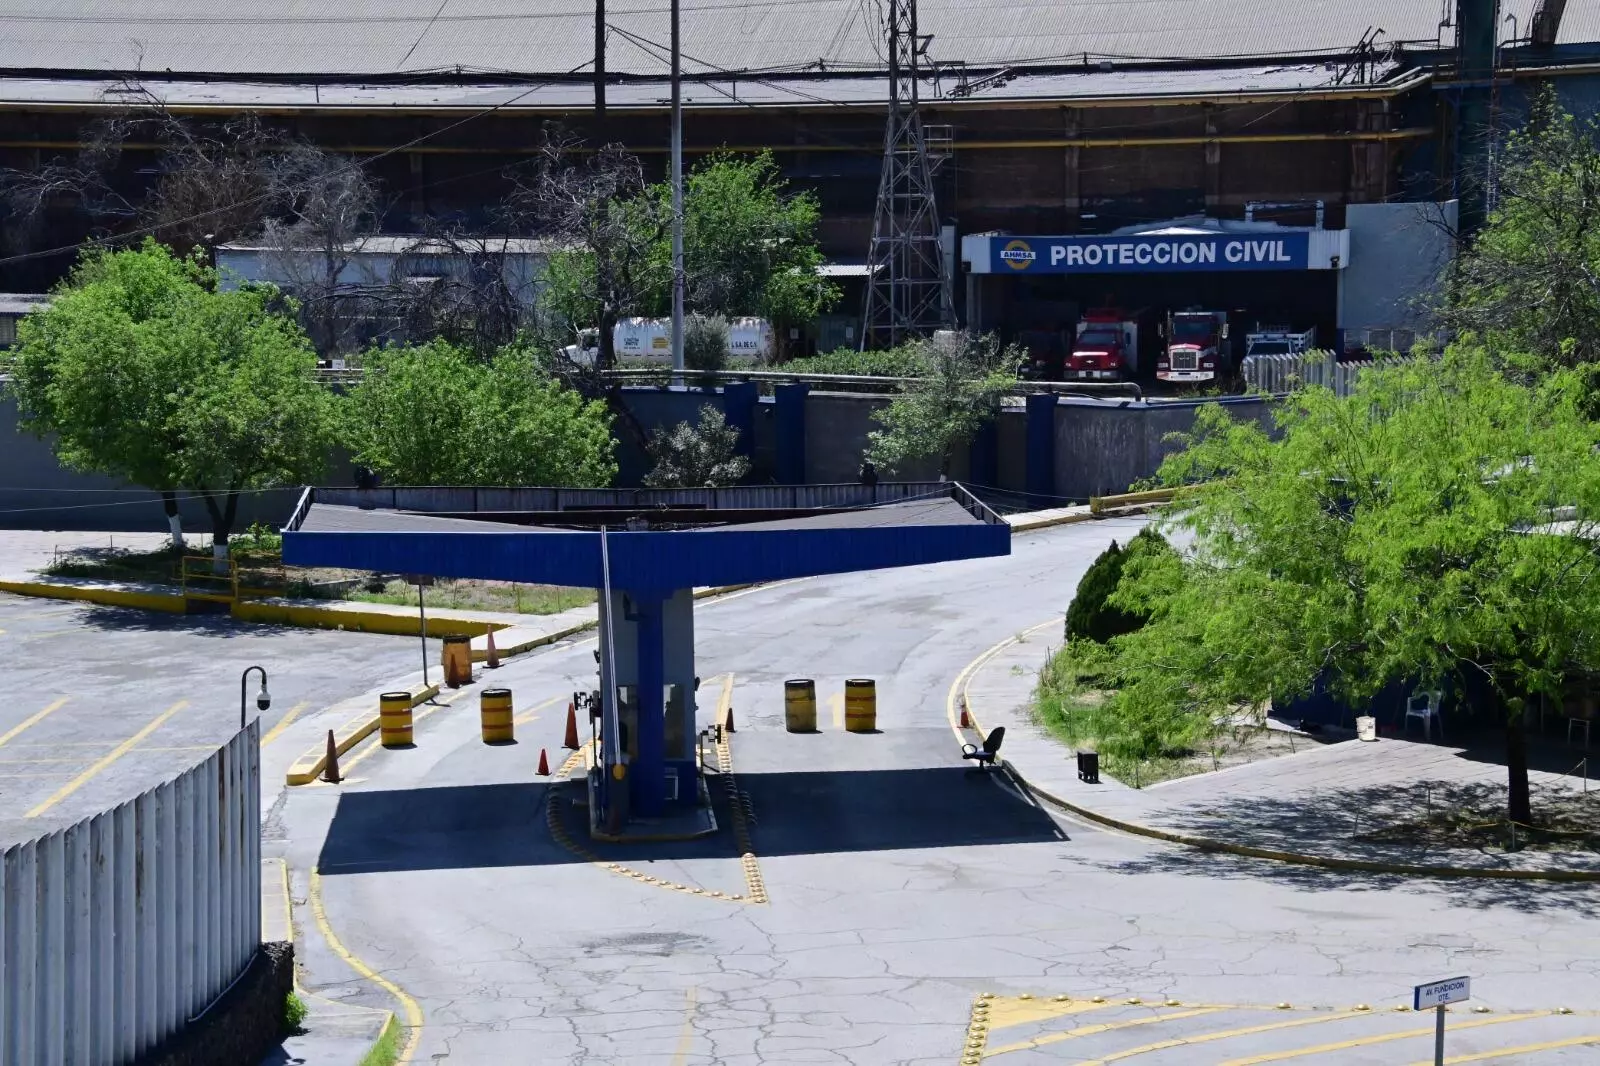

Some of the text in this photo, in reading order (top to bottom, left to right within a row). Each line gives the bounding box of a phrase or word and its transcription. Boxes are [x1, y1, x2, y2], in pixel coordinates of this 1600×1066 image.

[1003, 251, 1033, 259] AHMSA
[1050, 240, 1291, 266] PROTECCION CIVIL
